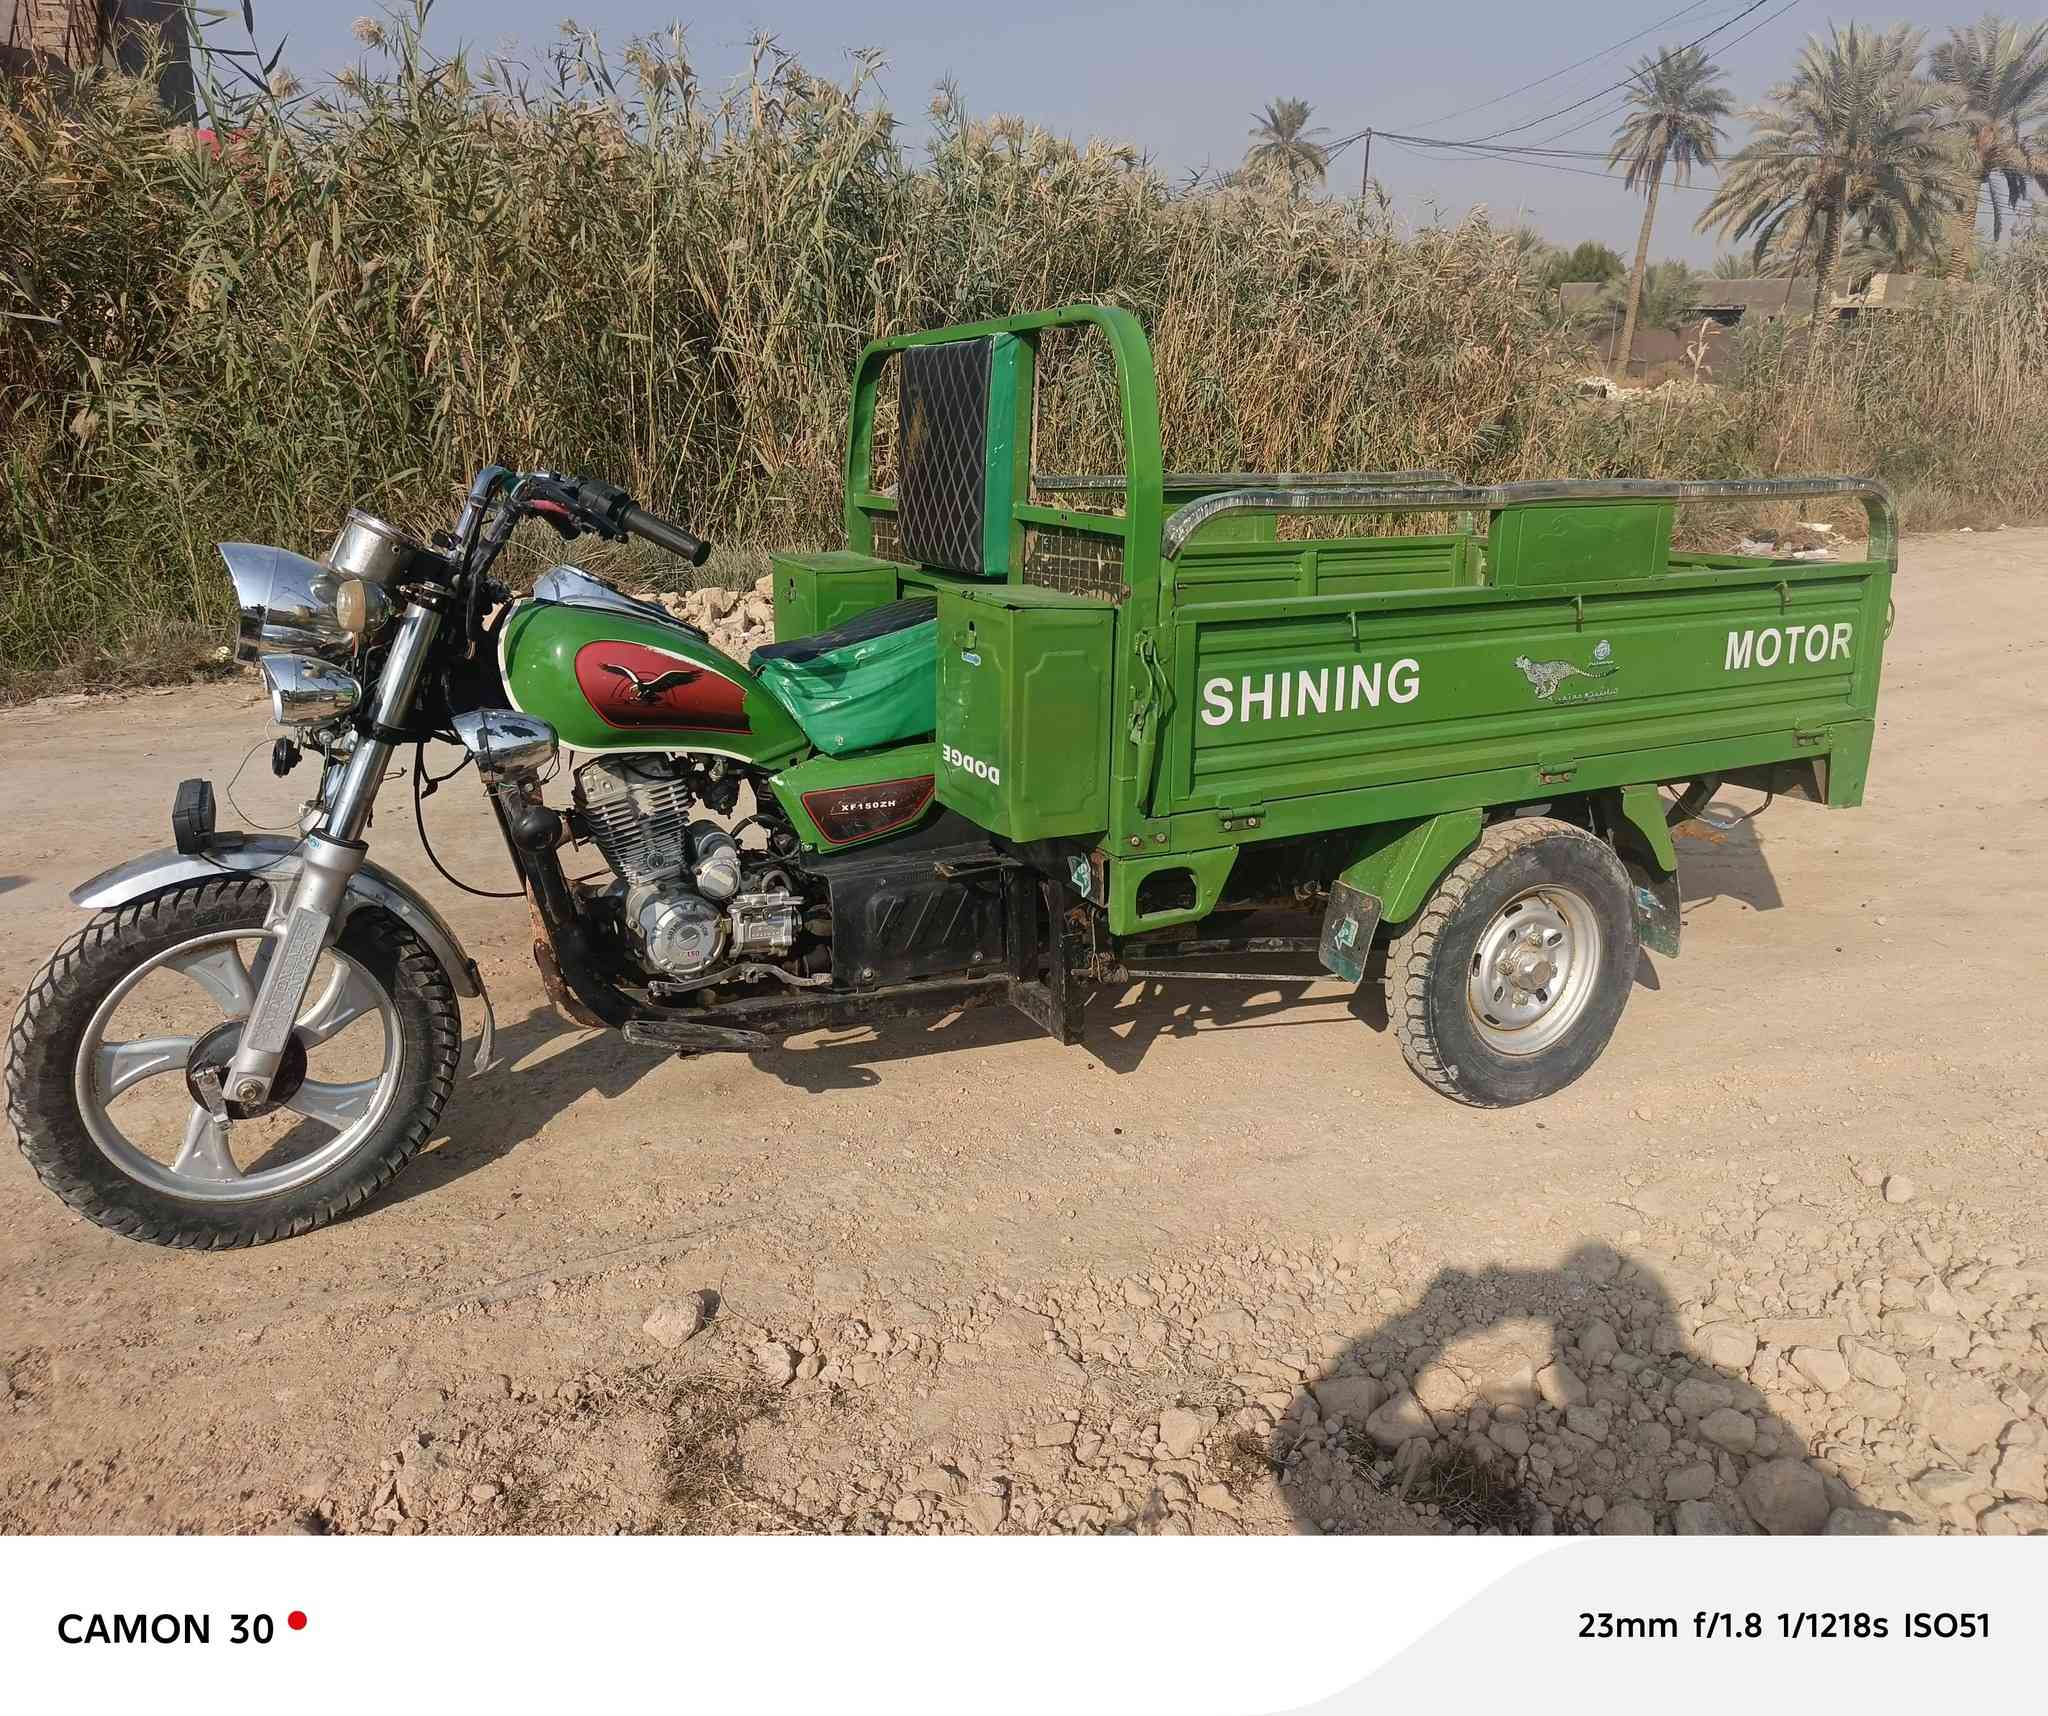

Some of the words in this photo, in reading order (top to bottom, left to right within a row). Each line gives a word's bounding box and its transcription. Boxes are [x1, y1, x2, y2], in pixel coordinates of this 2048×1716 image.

[1201, 658, 1420, 726] SHINING
[1724, 622, 1853, 671] MOTOR
[942, 743, 1001, 786] DODGE
[841, 800, 897, 812] XF150ZH
